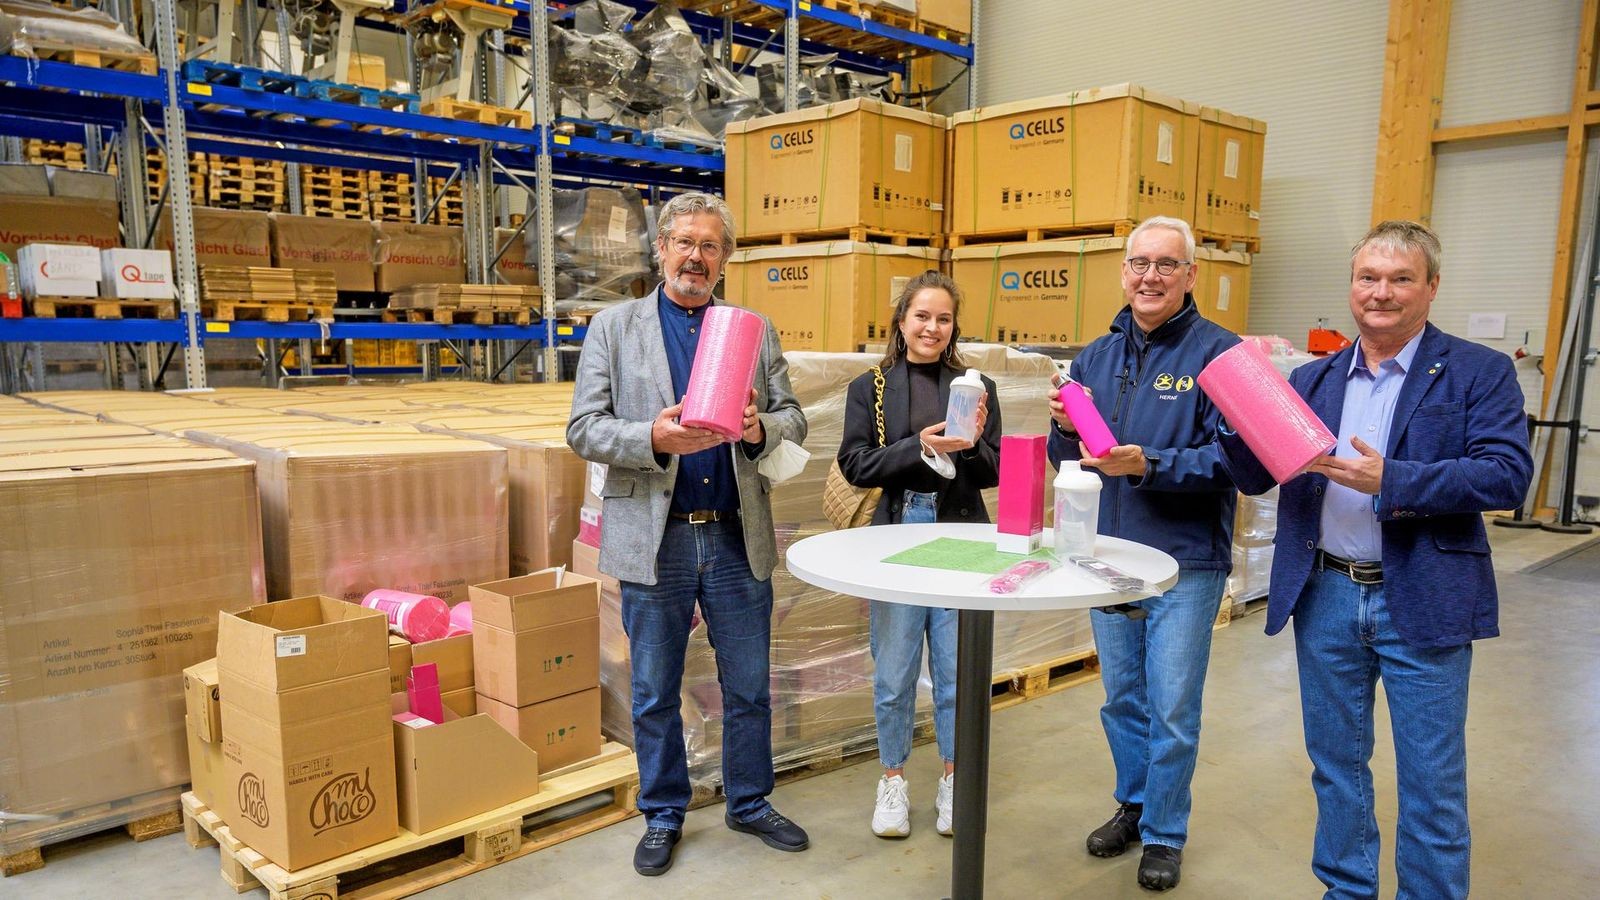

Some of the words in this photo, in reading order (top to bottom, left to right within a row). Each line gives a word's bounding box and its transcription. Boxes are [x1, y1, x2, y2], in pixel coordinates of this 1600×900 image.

[1023, 269, 1069, 289] CELLS
[1041, 293, 1069, 302] Germany
[164, 631, 194, 644] 100235
